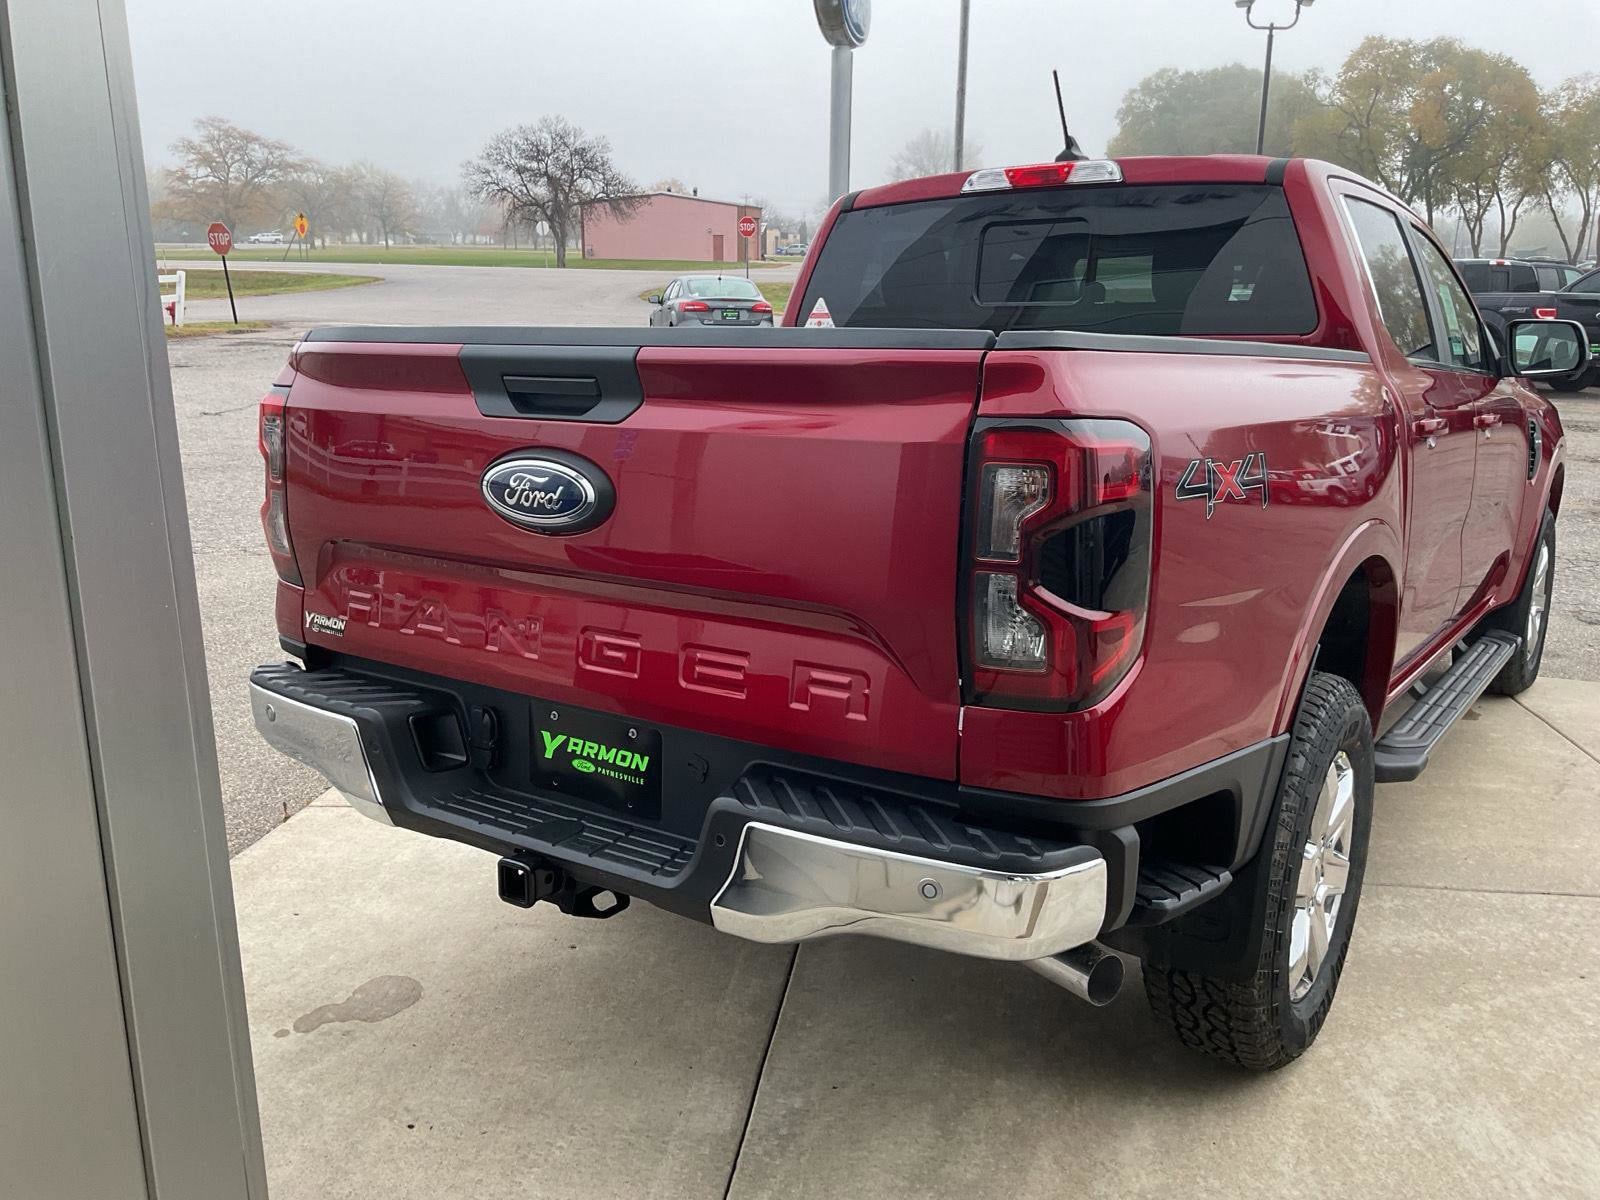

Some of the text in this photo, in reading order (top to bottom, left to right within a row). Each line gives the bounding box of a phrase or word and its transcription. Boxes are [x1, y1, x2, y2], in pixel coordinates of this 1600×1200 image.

[740, 222, 755, 232] STOP
[209, 232, 230, 246] STOP
[504, 472, 564, 511] Ford
[305, 610, 346, 630] YARMON
[341, 588, 872, 723] RANGER
[541, 730, 650, 772] YARMON
[597, 766, 645, 786] PAYNESVILLE
